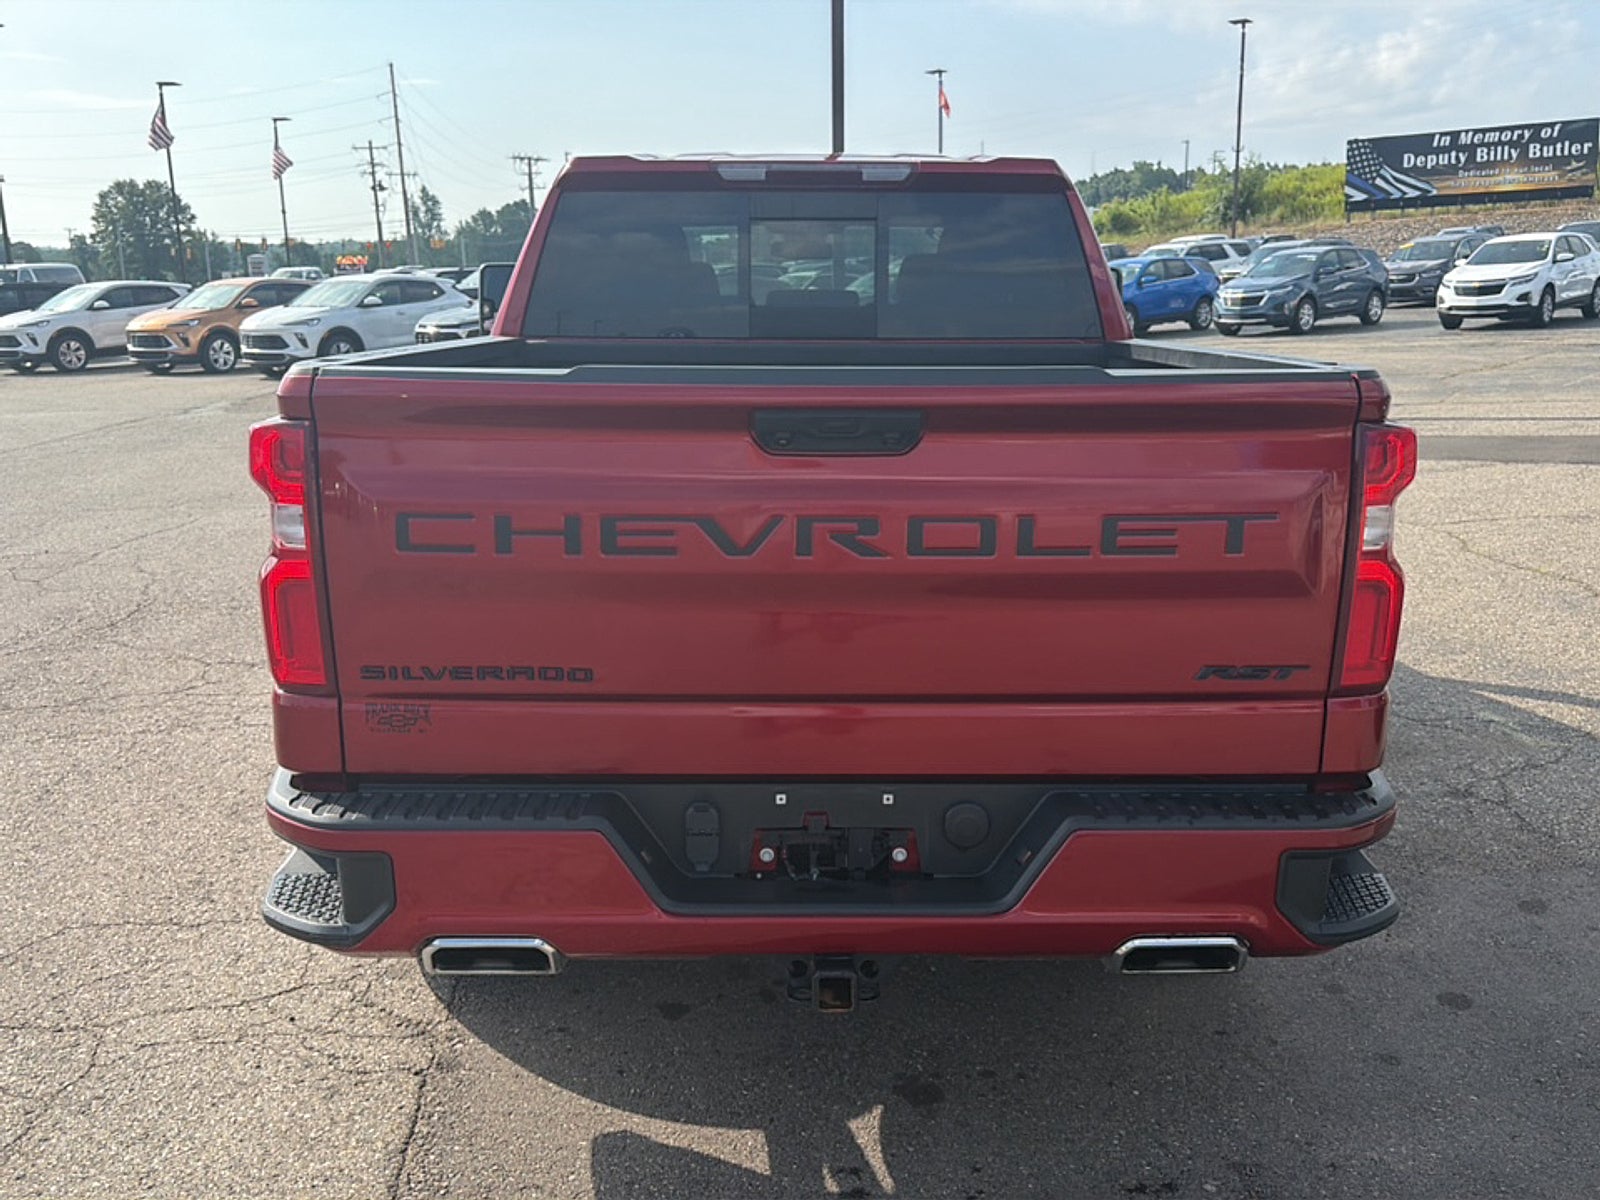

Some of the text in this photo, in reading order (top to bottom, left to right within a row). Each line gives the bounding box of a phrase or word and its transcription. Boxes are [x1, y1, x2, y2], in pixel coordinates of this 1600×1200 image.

[1432, 123, 1562, 148] In Memory of
[1403, 141, 1593, 170] Deputy Billy Butler
[395, 511, 1280, 558] CHEVROLET
[360, 665, 594, 683] SILVERADO
[1194, 664, 1311, 681] RST
